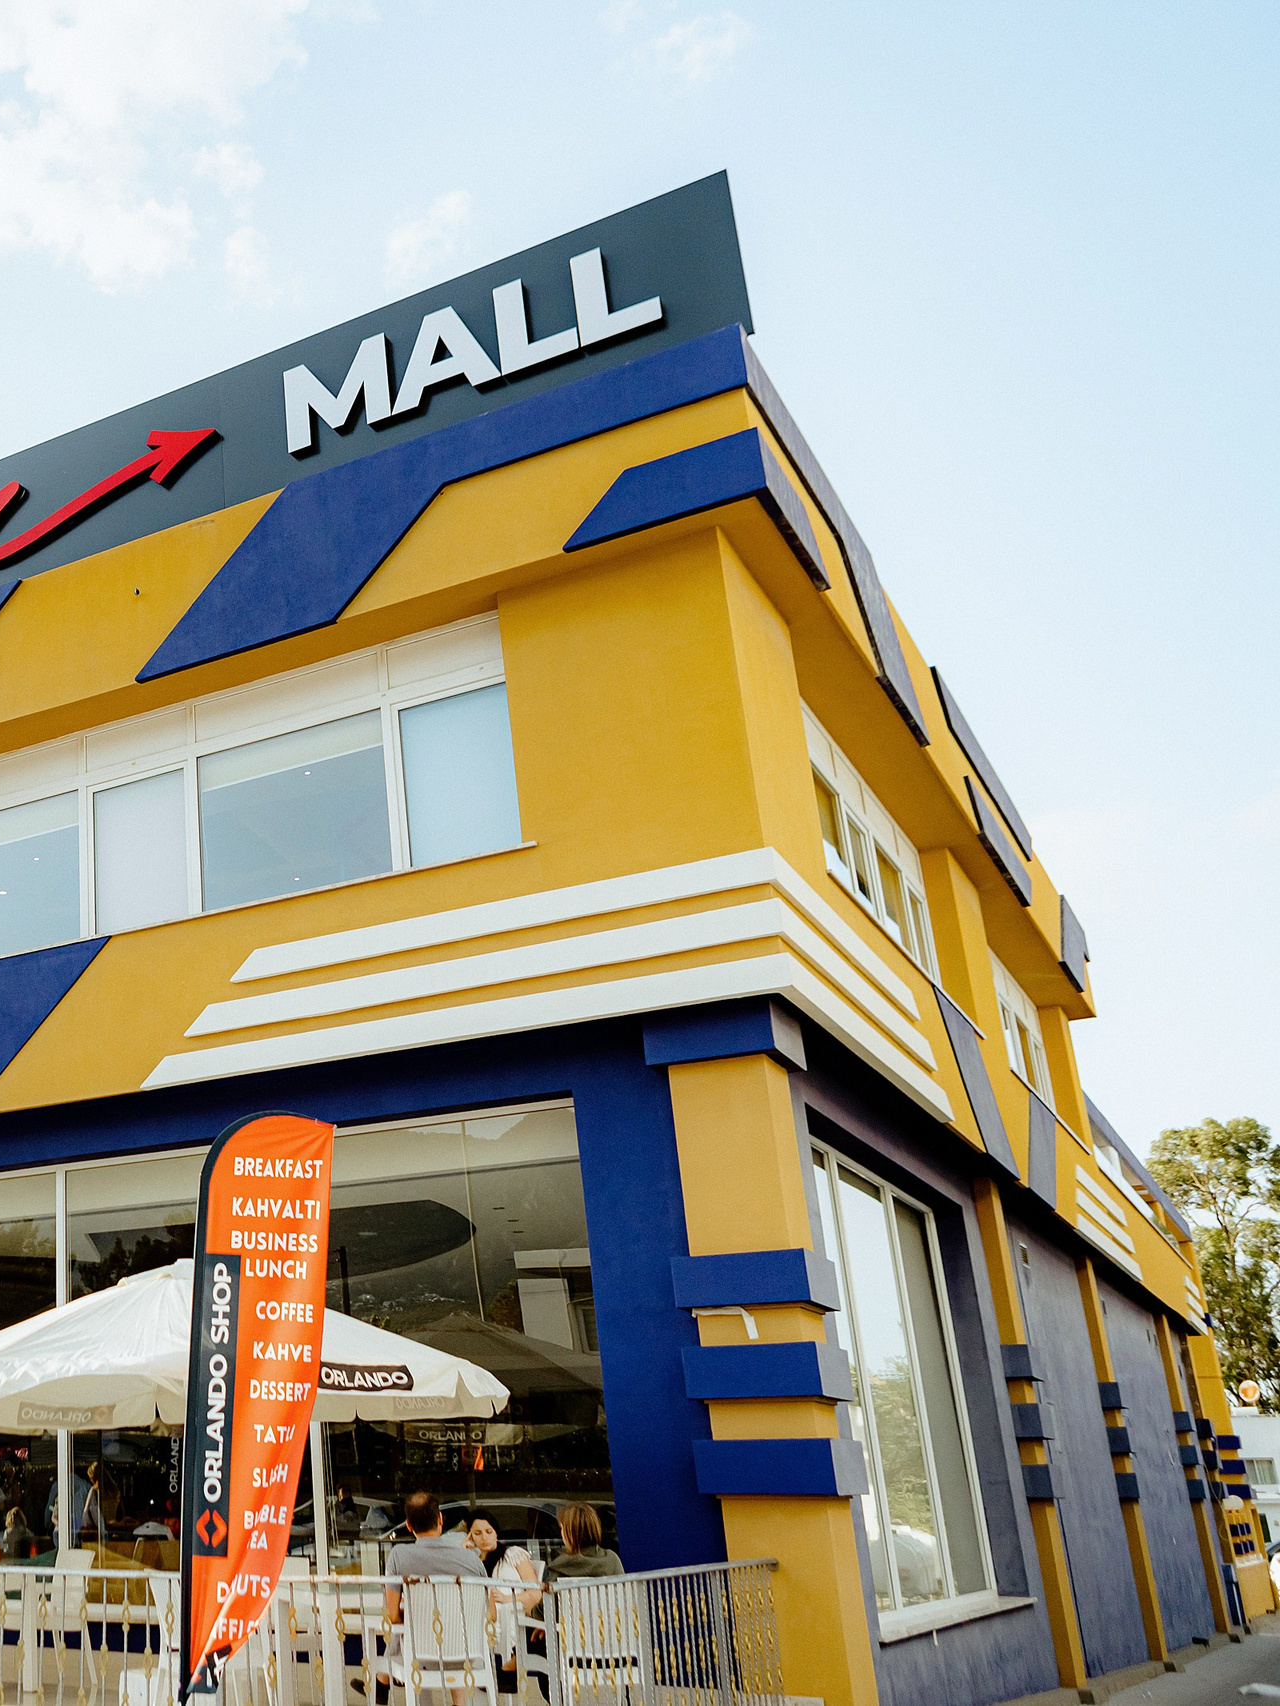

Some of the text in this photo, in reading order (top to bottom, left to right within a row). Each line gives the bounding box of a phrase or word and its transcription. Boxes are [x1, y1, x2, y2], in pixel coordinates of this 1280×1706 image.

[283, 247, 664, 455] MALL
[233, 1156, 324, 1179] BREAKFAST
[231, 1196, 321, 1221] KAHVALTI
[230, 1230, 319, 1253] BUSINESS
[244, 1258, 308, 1280] LUNCH
[255, 1300, 314, 1323] COFFEE
[252, 1341, 313, 1363] KAHVE
[203, 1262, 232, 1503] ORLANDO SHOP
[321, 1366, 409, 1388] ORLANDO
[249, 1378, 311, 1402] DESSERT
[419, 1429, 483, 1441] ORLANO
[243, 1504, 288, 1530] BBLE
[246, 1530, 268, 1550] EA
[217, 1573, 271, 1603] DUTS
